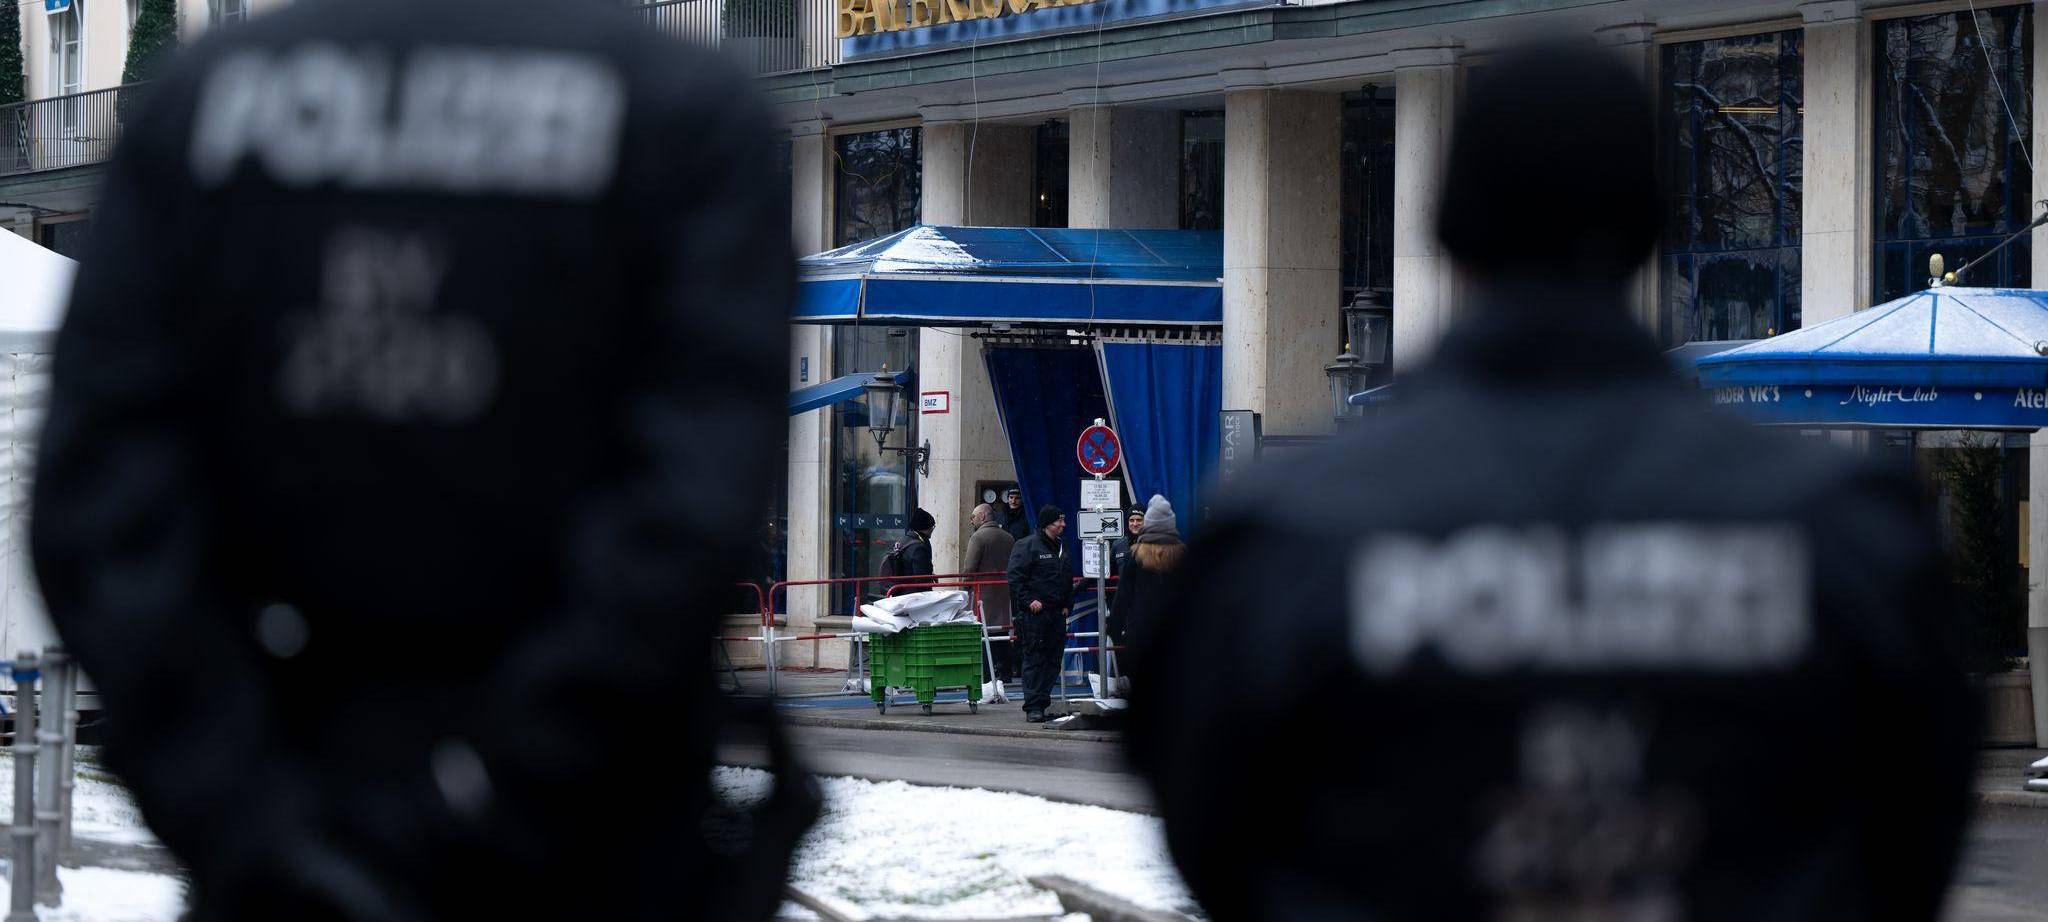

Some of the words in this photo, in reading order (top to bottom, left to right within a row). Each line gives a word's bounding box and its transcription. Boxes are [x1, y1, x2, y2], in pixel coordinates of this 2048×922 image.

[194, 44, 622, 196] POLIZEI
[1712, 386, 1745, 404] RADER
[1840, 385, 1896, 407] Night
[1897, 386, 1938, 402] Club
[1350, 523, 1812, 674] POLIZEI
